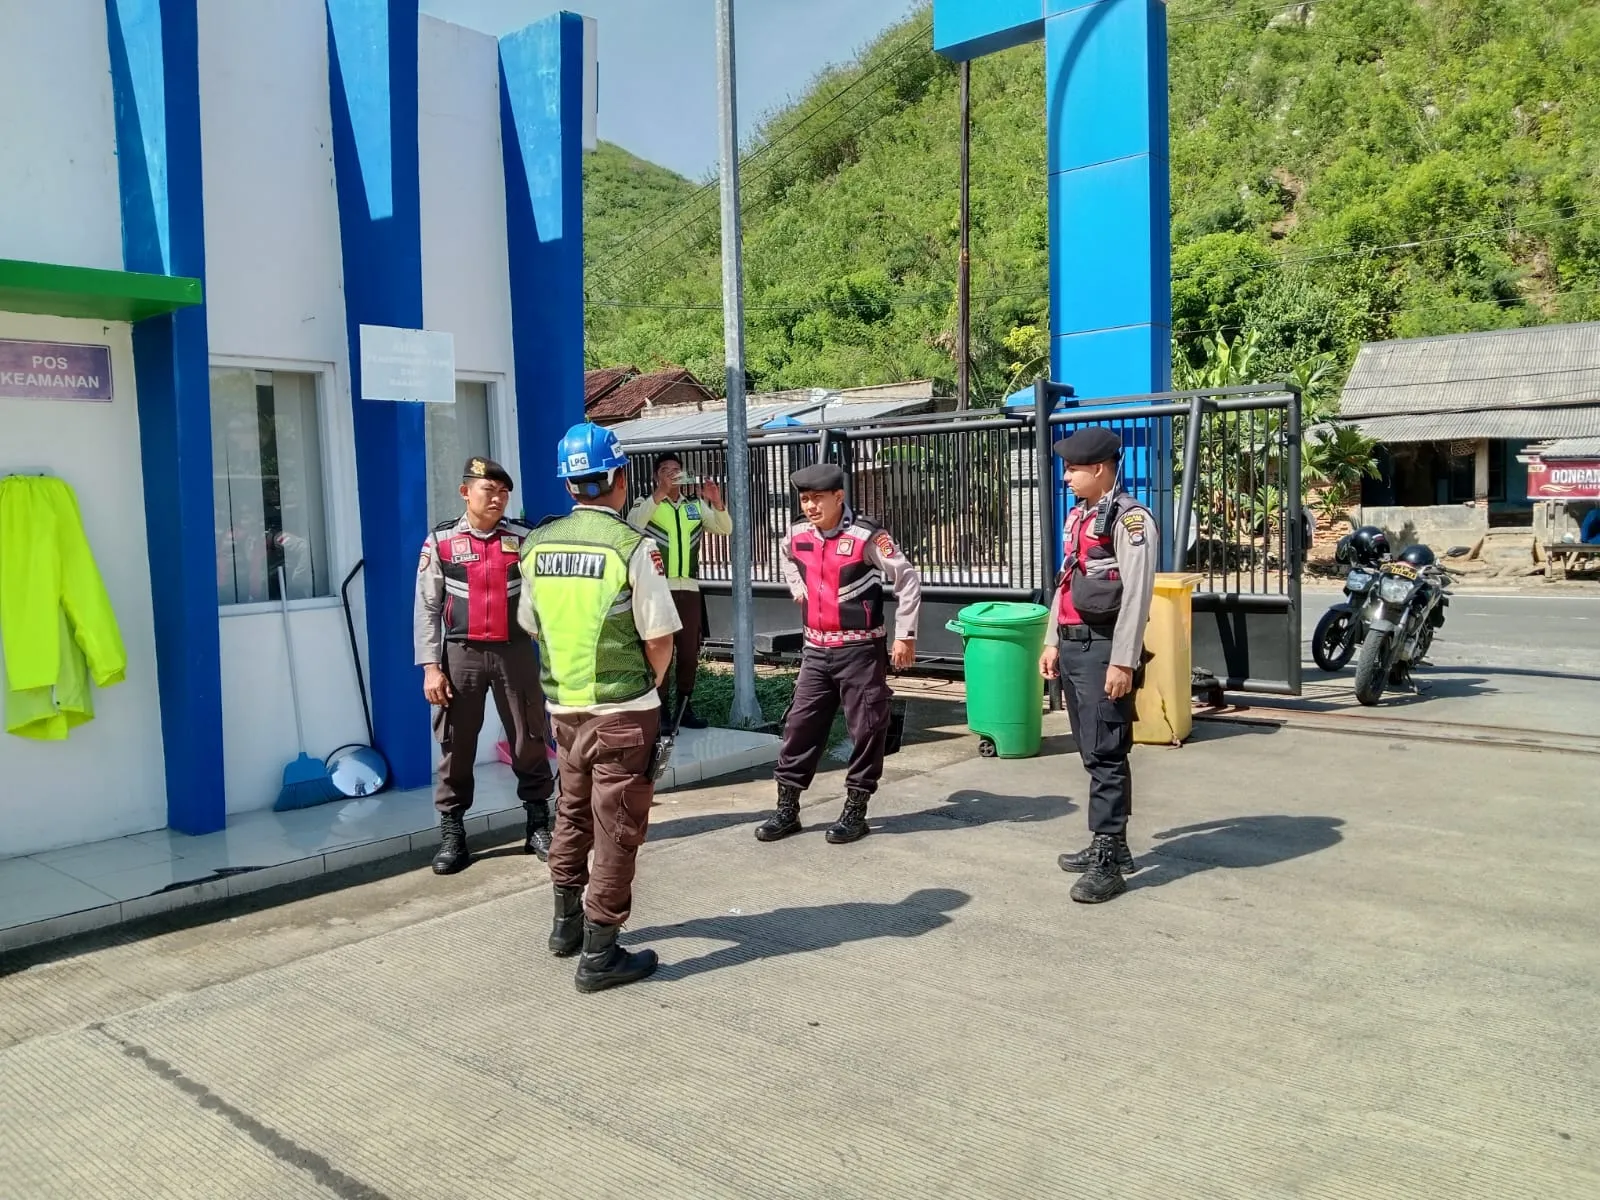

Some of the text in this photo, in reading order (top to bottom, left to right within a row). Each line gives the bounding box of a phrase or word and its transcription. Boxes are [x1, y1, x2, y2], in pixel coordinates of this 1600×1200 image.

[32, 355, 68, 370] POS
[0, 371, 100, 388] KEAMANAN
[570, 456, 587, 467] LPG
[536, 552, 604, 577] SECURITY
